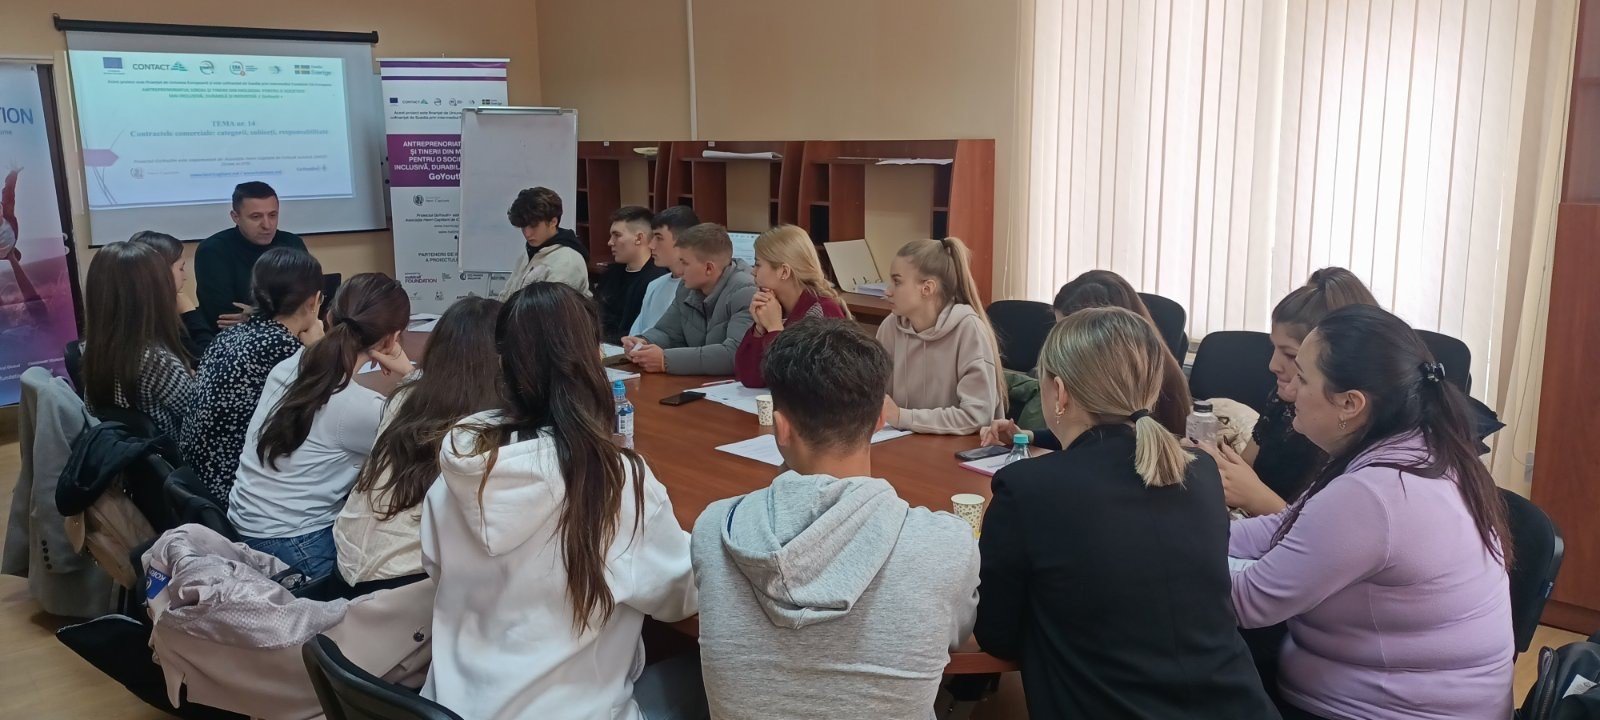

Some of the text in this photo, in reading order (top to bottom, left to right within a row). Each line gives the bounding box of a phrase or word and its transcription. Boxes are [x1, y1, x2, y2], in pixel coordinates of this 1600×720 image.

[132, 63, 170, 71] CONTACT
[0, 107, 34, 125] ION
[394, 163, 431, 171] INCLUSIVĂ,
